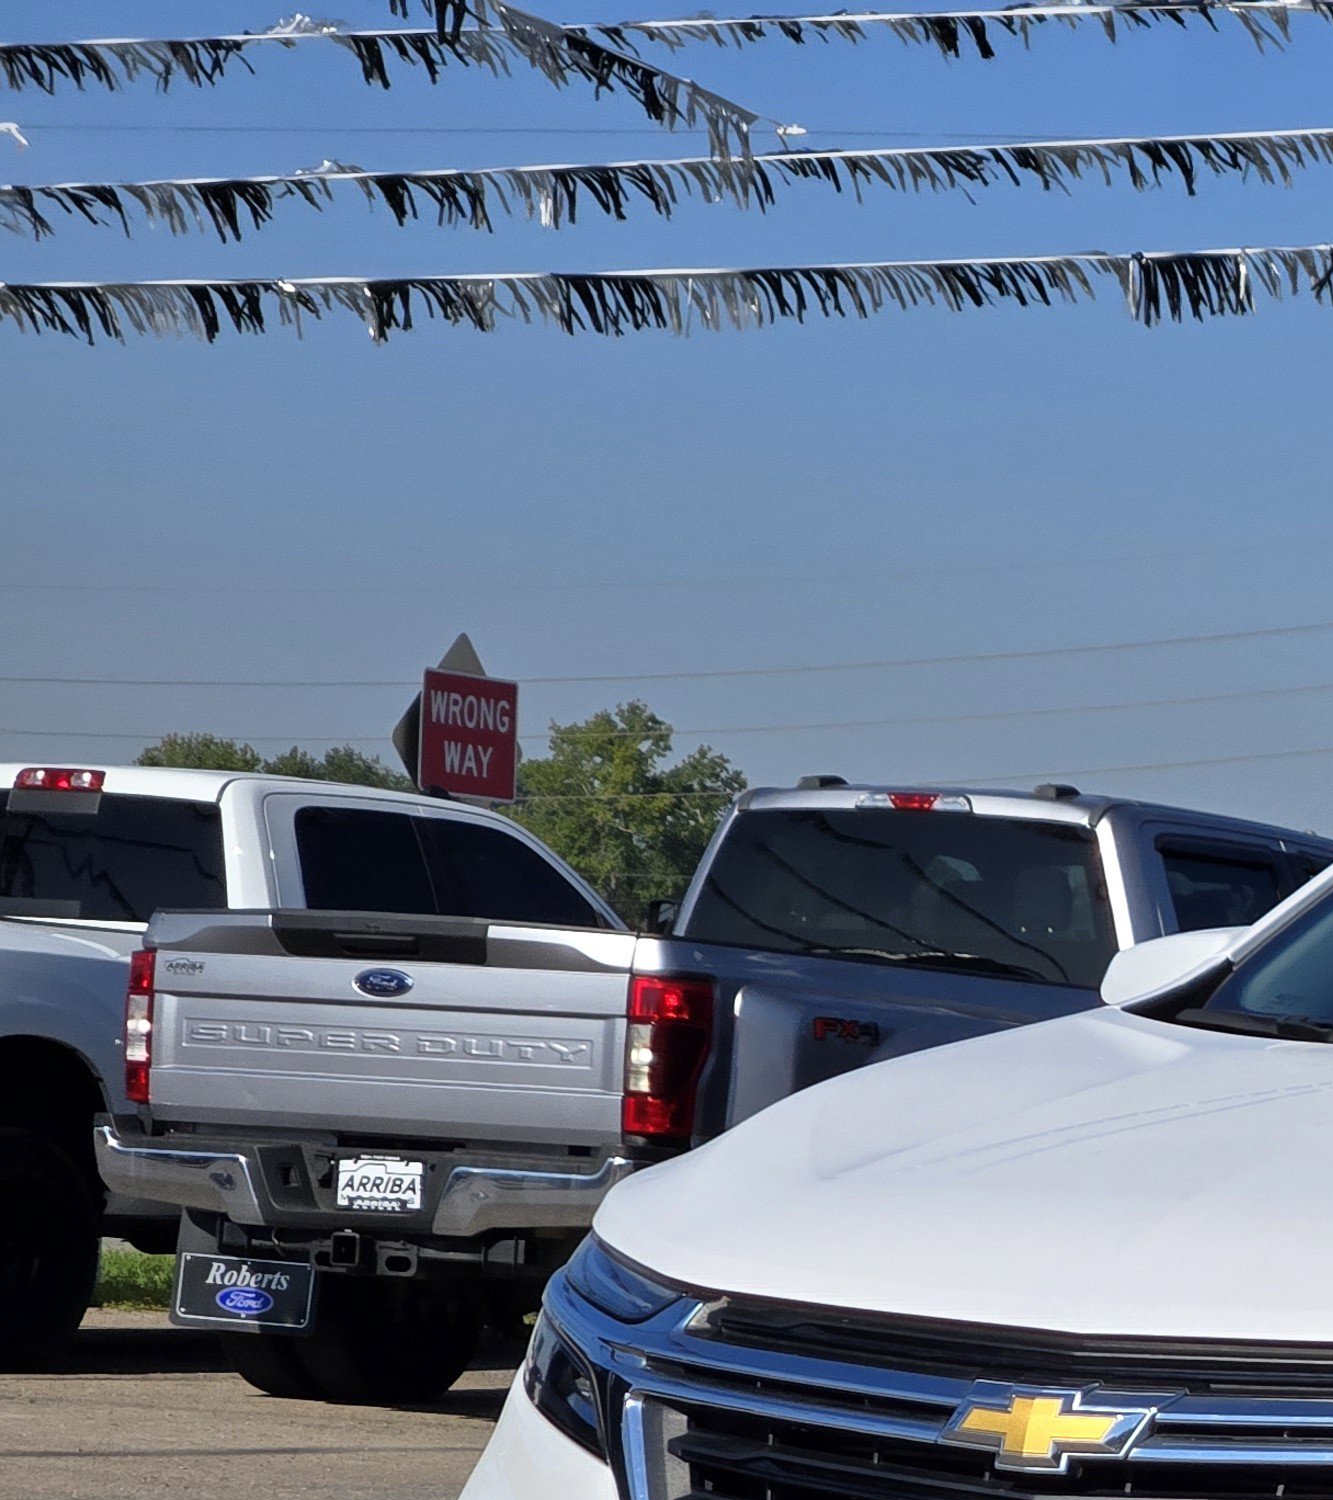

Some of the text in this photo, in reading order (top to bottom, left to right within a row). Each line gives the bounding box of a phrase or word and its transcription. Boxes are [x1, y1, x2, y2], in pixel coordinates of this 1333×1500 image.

[431, 690, 510, 733] WRONG
[444, 740, 493, 778] WAY
[190, 1024, 588, 1063] SUPER DUTY
[813, 1016, 881, 1045] FX4
[341, 1174, 417, 1195] ARRIBA
[205, 1262, 291, 1291] Roberts
[225, 1291, 265, 1309] Ford
